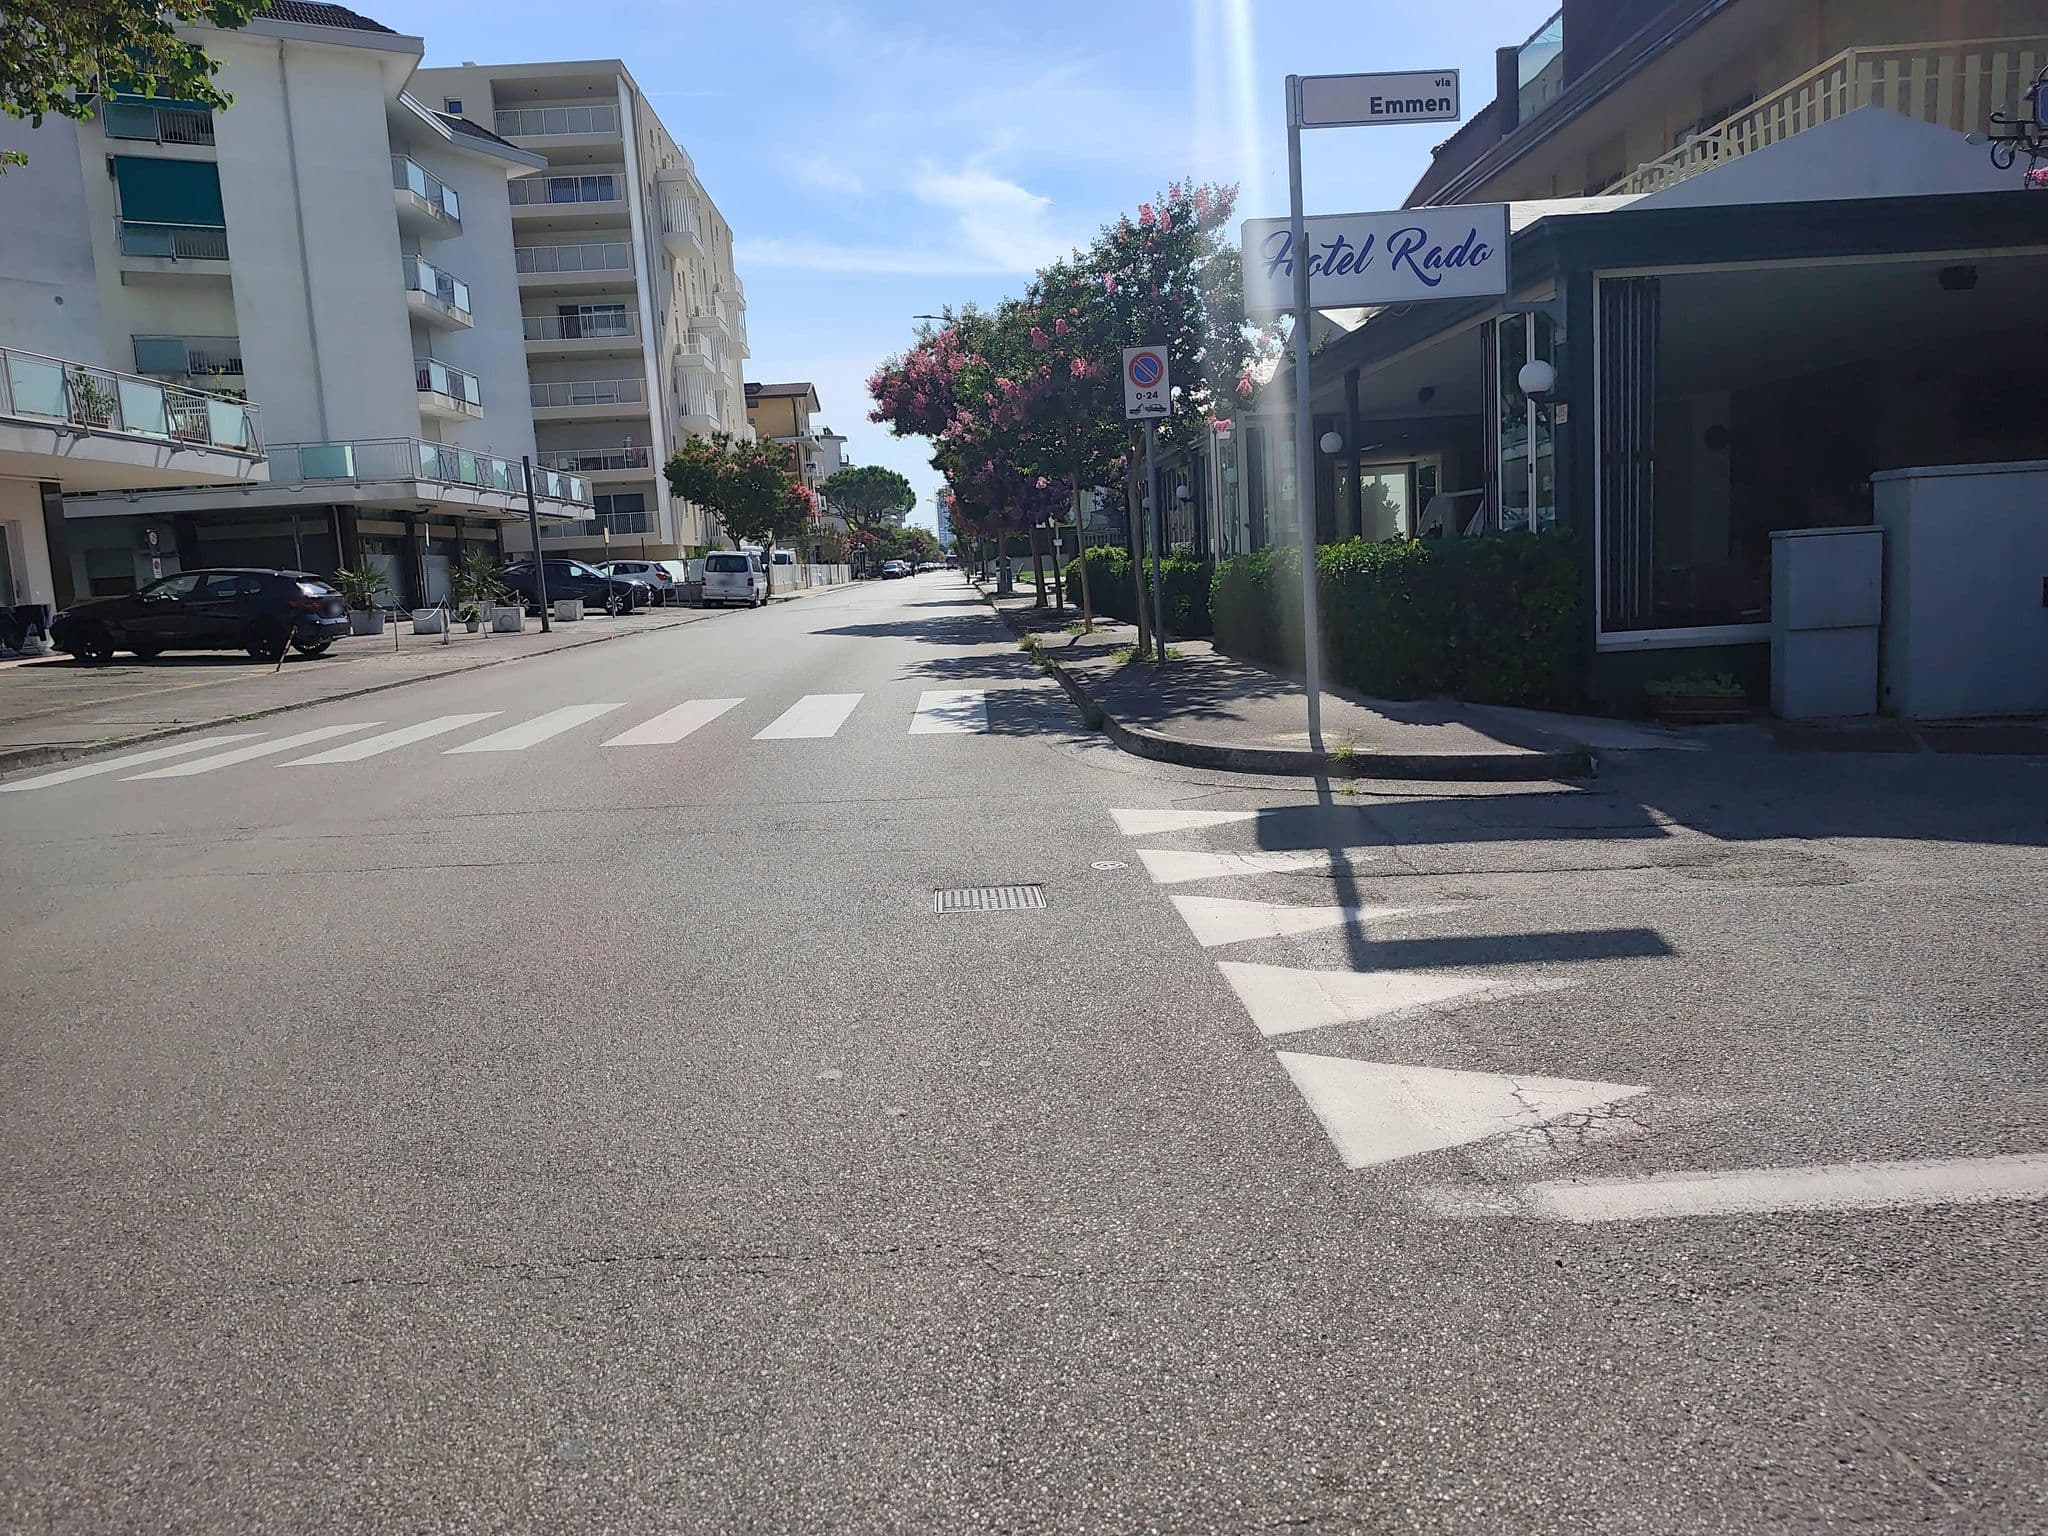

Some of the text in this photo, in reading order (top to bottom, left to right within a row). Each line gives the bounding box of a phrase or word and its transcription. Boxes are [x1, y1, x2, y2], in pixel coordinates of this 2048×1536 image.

[1434, 77, 1451, 87] via
[1370, 96, 1451, 115] Emmen
[1260, 227, 1494, 287] Hotel Rado
[1136, 391, 1159, 400] 0-24
